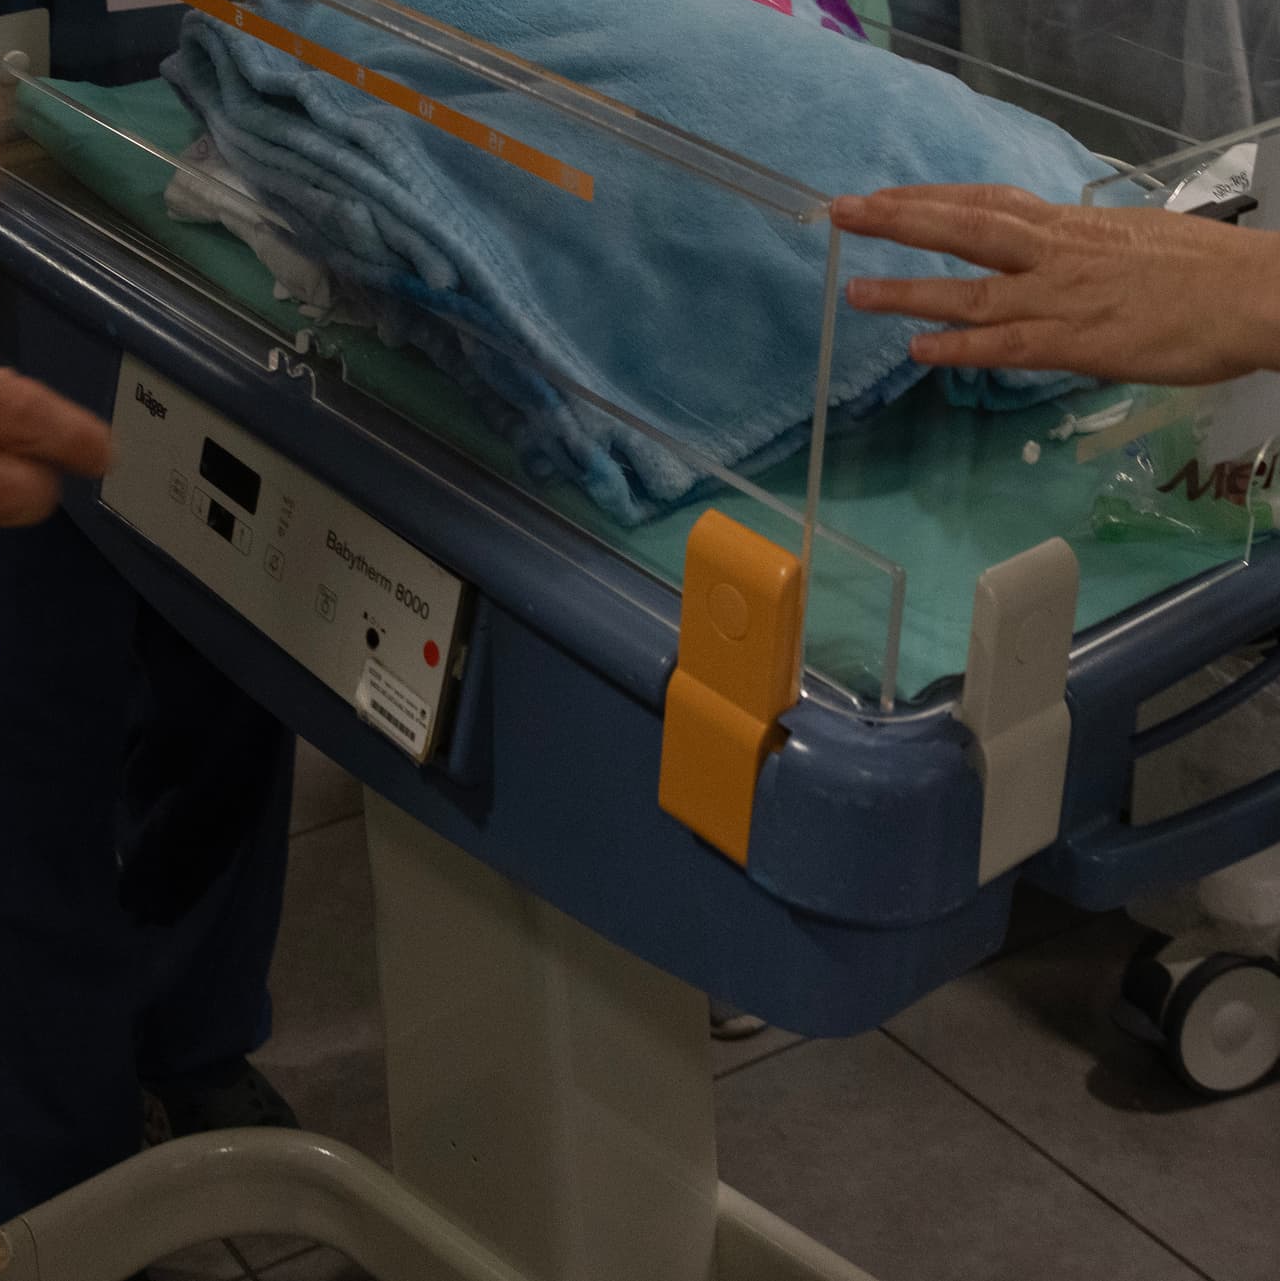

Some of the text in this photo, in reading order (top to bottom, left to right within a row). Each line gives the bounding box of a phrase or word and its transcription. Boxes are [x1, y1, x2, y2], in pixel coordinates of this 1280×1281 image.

[135, 382, 168, 420] Dräger
[326, 528, 430, 621] Babytherm 8000
